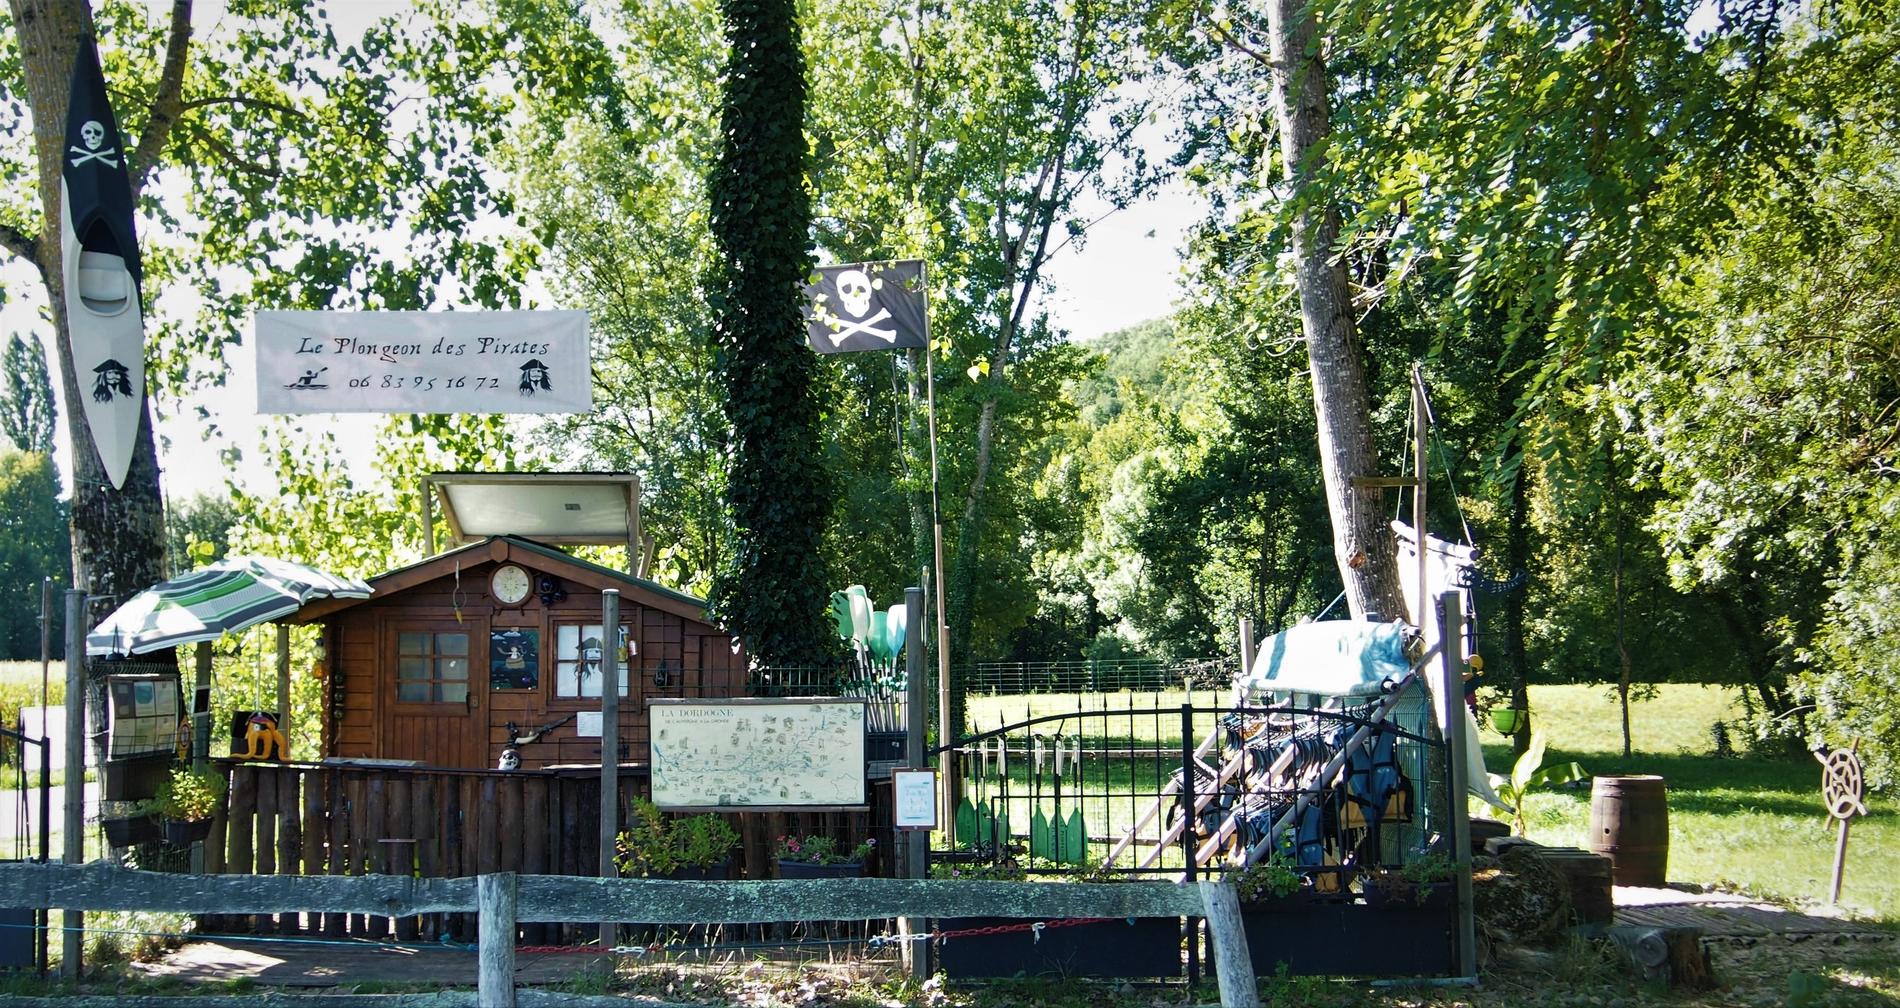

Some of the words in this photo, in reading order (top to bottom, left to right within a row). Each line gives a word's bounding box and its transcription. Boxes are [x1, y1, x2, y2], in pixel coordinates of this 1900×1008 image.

[296, 337, 323, 355] Le
[334, 336, 421, 363] Plongeon
[432, 337, 466, 356] des
[477, 336, 550, 356] Pirates
[349, 374, 371, 388] 06
[381, 374, 404, 390] 83
[415, 376, 437, 392] 95
[446, 376, 466, 389] 16
[476, 376, 500, 391] 72
